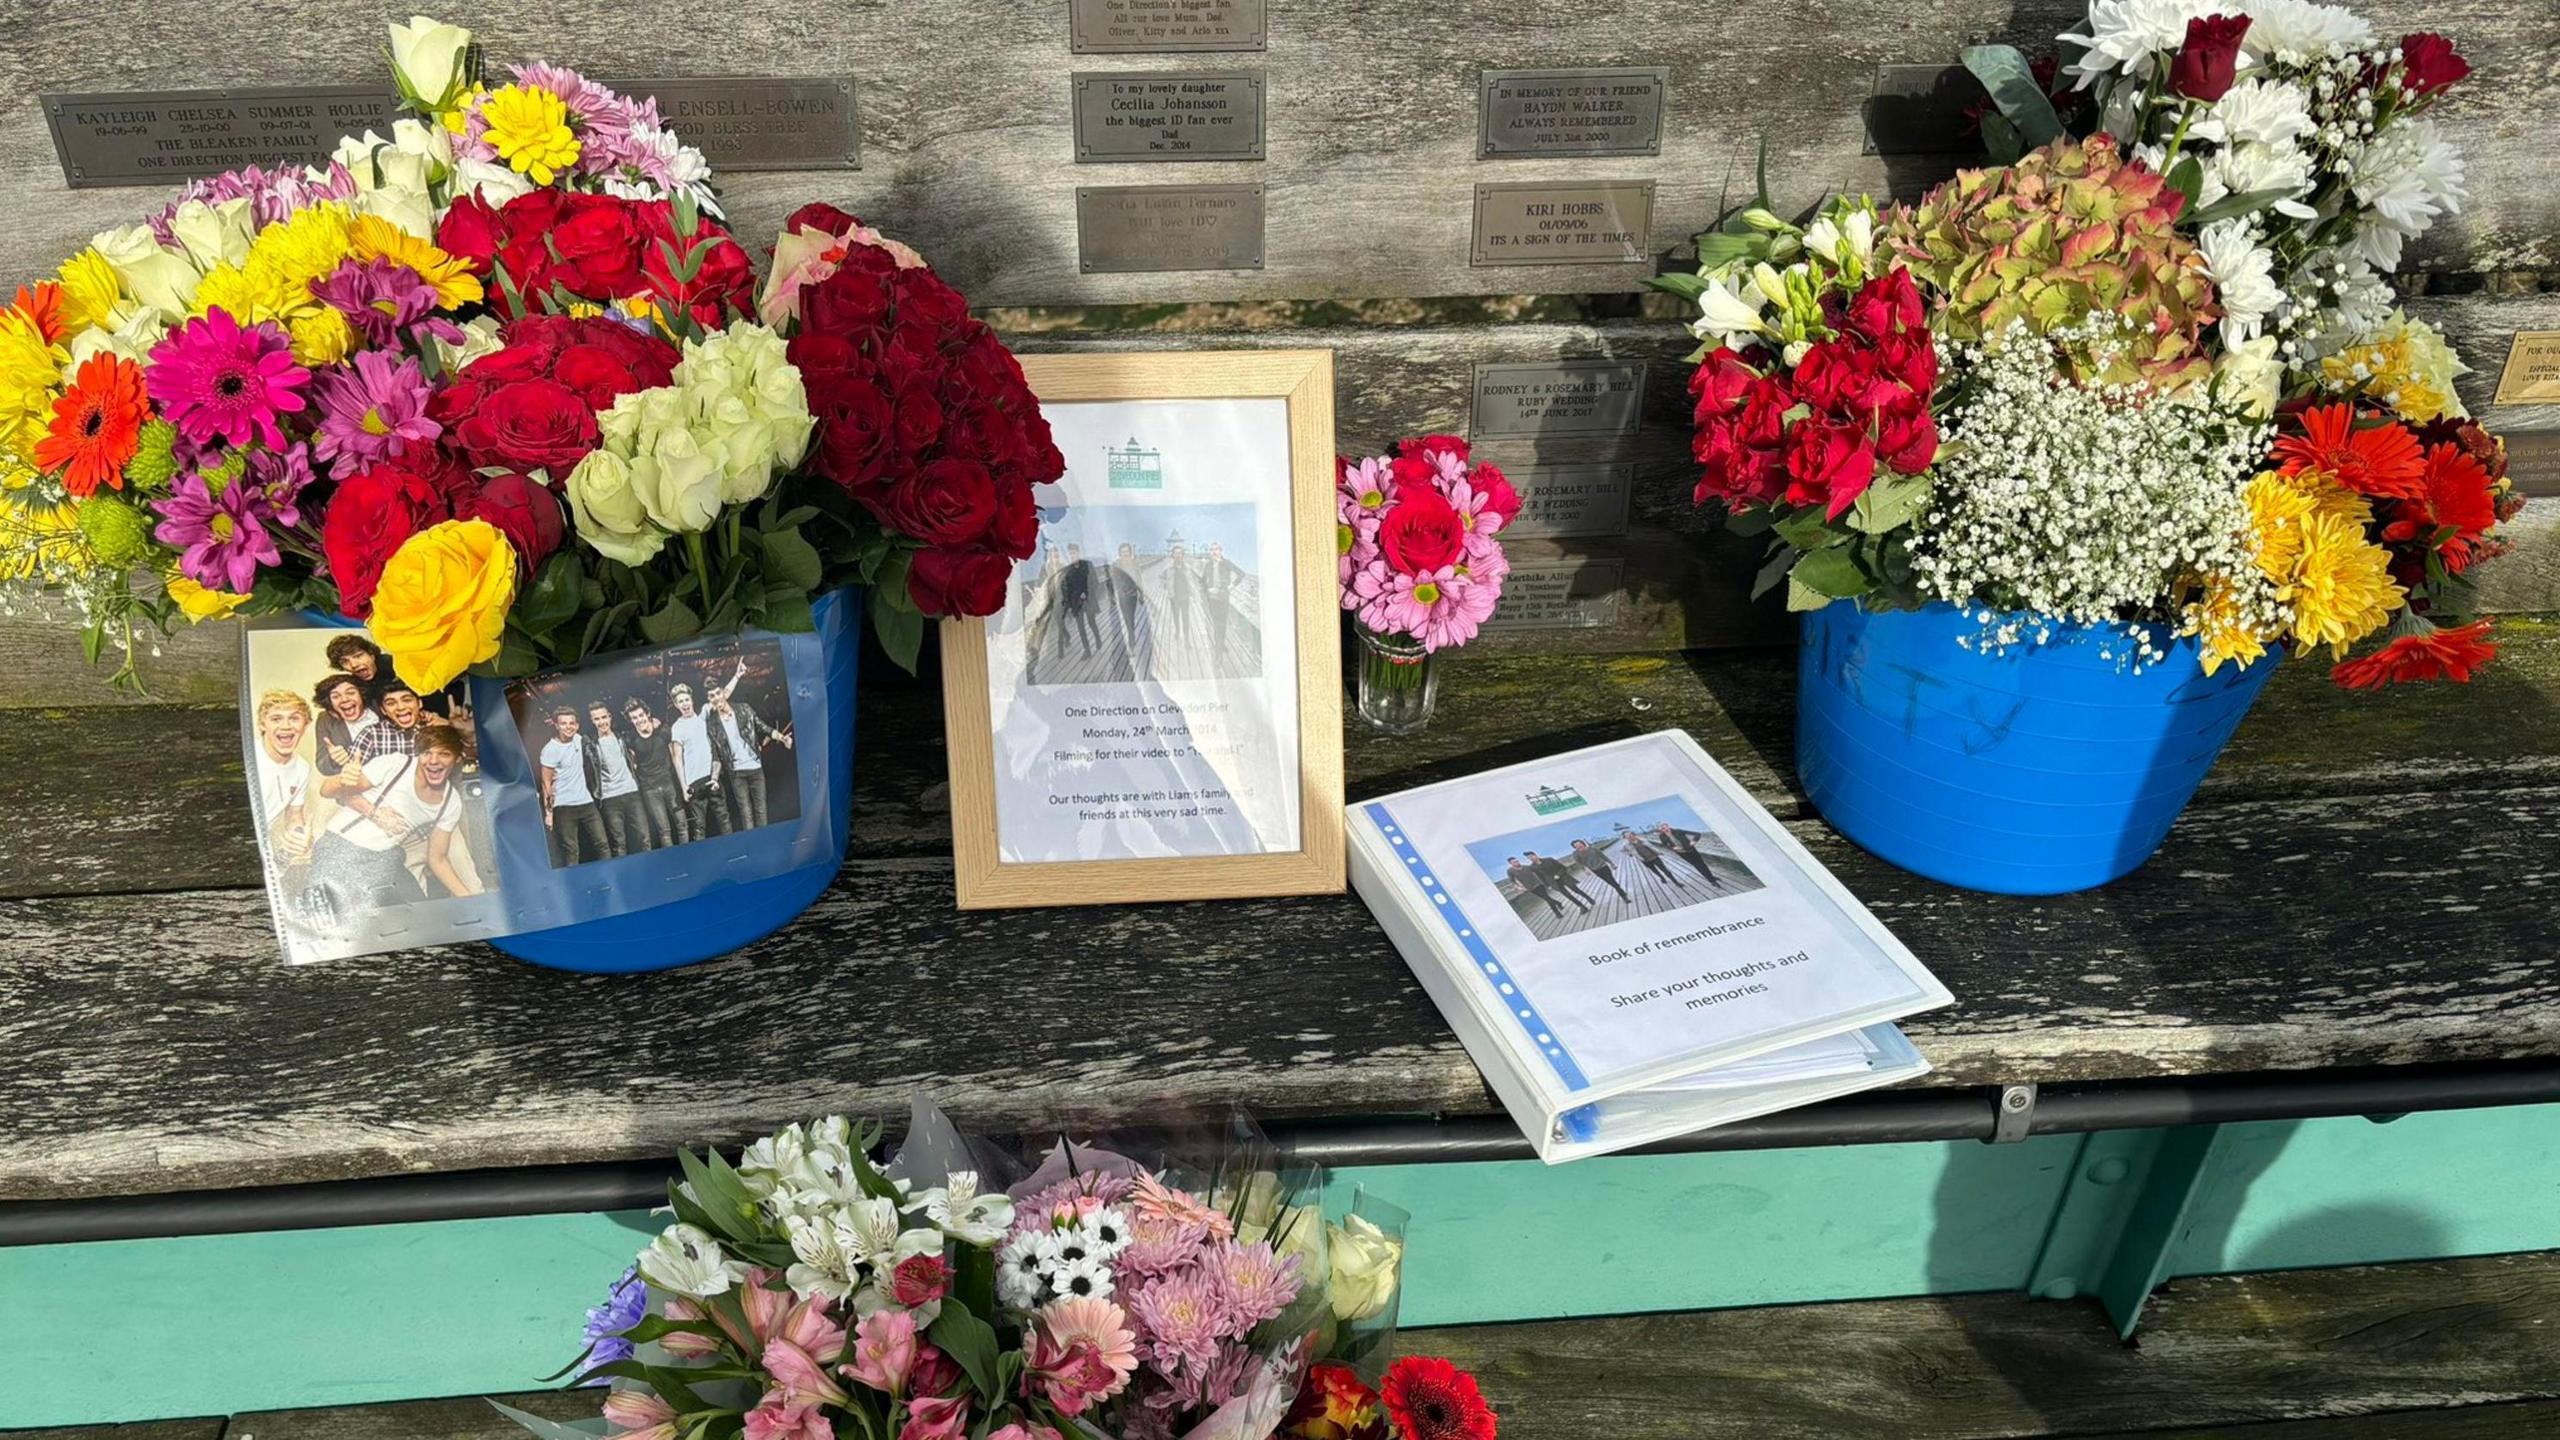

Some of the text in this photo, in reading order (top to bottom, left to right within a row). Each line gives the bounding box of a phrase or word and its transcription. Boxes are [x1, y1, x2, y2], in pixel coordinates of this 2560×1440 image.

[1112, 83, 1226, 95] To my lovely daughter
[1500, 84, 1651, 99] IN MEMORY OF OUR FRIEND
[679, 99, 835, 118] ENSELL-BOWEN
[1111, 97, 1227, 111] Cecilia Johansson
[1524, 100, 1624, 114] HAYDN WALKER
[75, 103, 384, 125] KAYLEIGH CHELSEA SUMMER HOLLIE
[1105, 116, 1124, 126] the
[1128, 115, 1167, 128] biggest
[1187, 114, 1206, 126] fan
[1210, 115, 1234, 126] ever
[673, 121, 705, 136] GOD
[712, 120, 760, 135] BLESS
[1509, 116, 1638, 129] ALWAYS REMEMBERED
[1161, 129, 1179, 140] Dad
[1534, 133, 1560, 145] JULY
[1585, 131, 1610, 143] 2000
[154, 134, 320, 152] THE BLEAKEN FAMILY
[137, 150, 333, 169] ONE DIRECTION BIGGEST FA
[1525, 202, 1604, 217] KIRI HOBBS
[1538, 219, 1589, 231] 01/09/06
[1490, 231, 1635, 246] ITS A SIGN OF THE TIMES
[1483, 384, 1529, 397] RODNEY
[1545, 382, 1605, 395] ROSEMARY
[1609, 380, 1635, 393] HILL
[1517, 395, 1600, 408] RUBY WEDDING
[1543, 407, 1568, 418] JUNE
[1572, 407, 1593, 418] 2017
[1534, 484, 1592, 496] ROSEMARY
[1596, 483, 1620, 494] HILL
[1543, 498, 1591, 510] WEDDING
[1532, 511, 1556, 522] JUNE
[1064, 706, 1088, 718] One
[1090, 704, 1139, 717] Direction
[1142, 706, 1156, 716] on
[1158, 703, 1207, 715] Clevdon
[1082, 723, 1217, 741] Monday, 24th March 014
[1053, 749, 1094, 763] Filming
[1095, 748, 1112, 760] for
[1113, 747, 1139, 759] their
[1141, 746, 1170, 758] video
[1173, 747, 1185, 758] to
[1049, 795, 1069, 806] Our
[1072, 793, 1120, 806] thoughts
[1122, 794, 1140, 804] are
[1141, 790, 1166, 802] with
[1200, 788, 1231, 801] family
[1078, 808, 1118, 821] friends
[1118, 810, 1131, 821] at
[1132, 807, 1152, 819] this
[1153, 809, 1177, 822] very
[1179, 806, 1198, 818] sad
[1588, 915, 1766, 967] Book of remembrance
[1609, 949, 1809, 1010] Share your thoughts and
[1684, 981, 1770, 1011] memories
